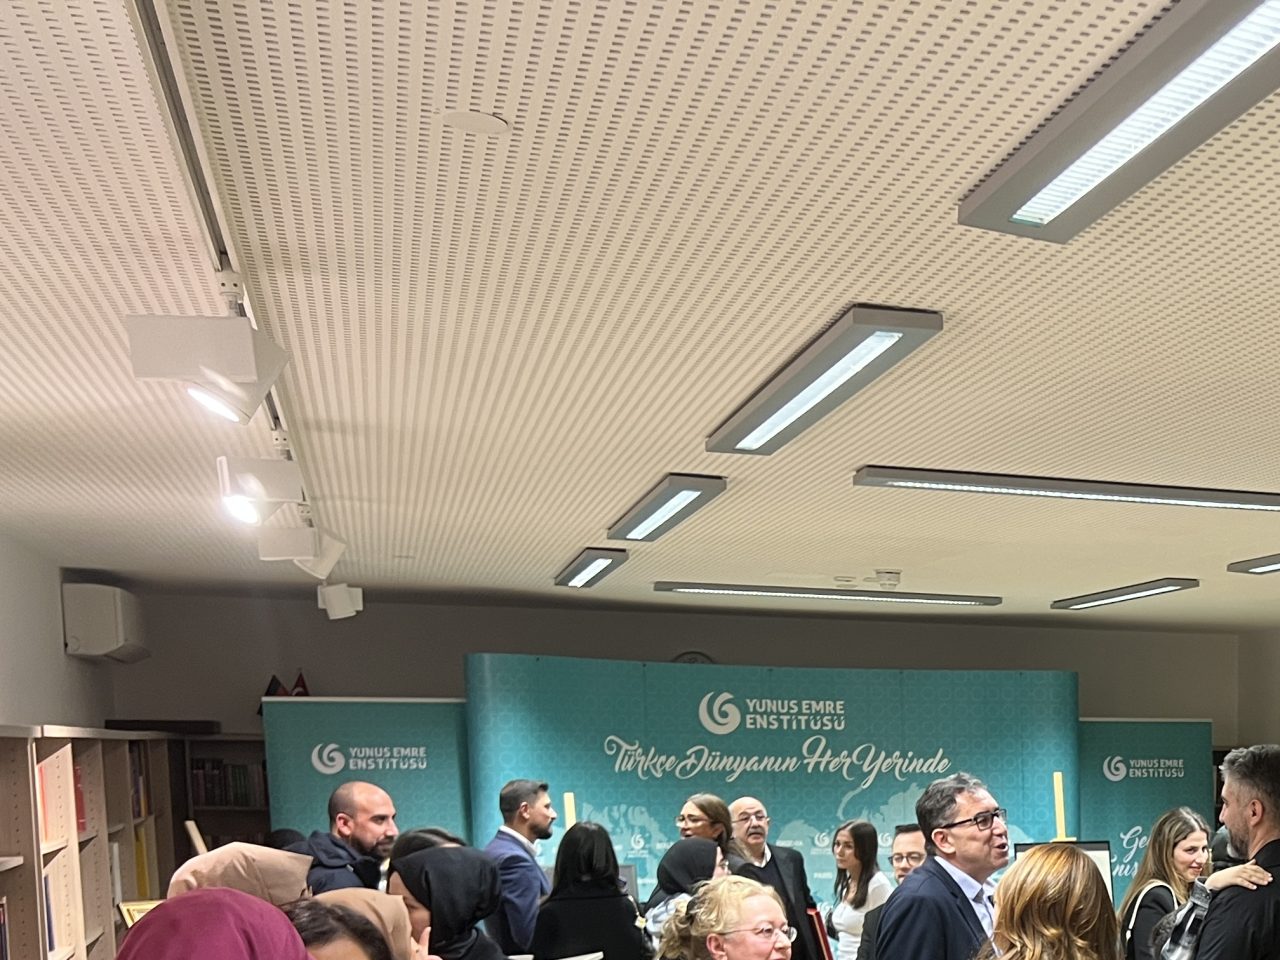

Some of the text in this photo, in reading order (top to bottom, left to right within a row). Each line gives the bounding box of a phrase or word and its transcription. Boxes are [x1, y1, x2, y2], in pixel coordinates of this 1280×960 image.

[746, 699, 845, 714] YUNUS EMRE
[746, 715, 845, 731] ENSTİTÜSÜ
[349, 747, 427, 758] YUNUS EMRE
[604, 735, 951, 789] Türkçe Dünyanın Her Yerinde
[1129, 759, 1184, 768] YUNUS EMRE
